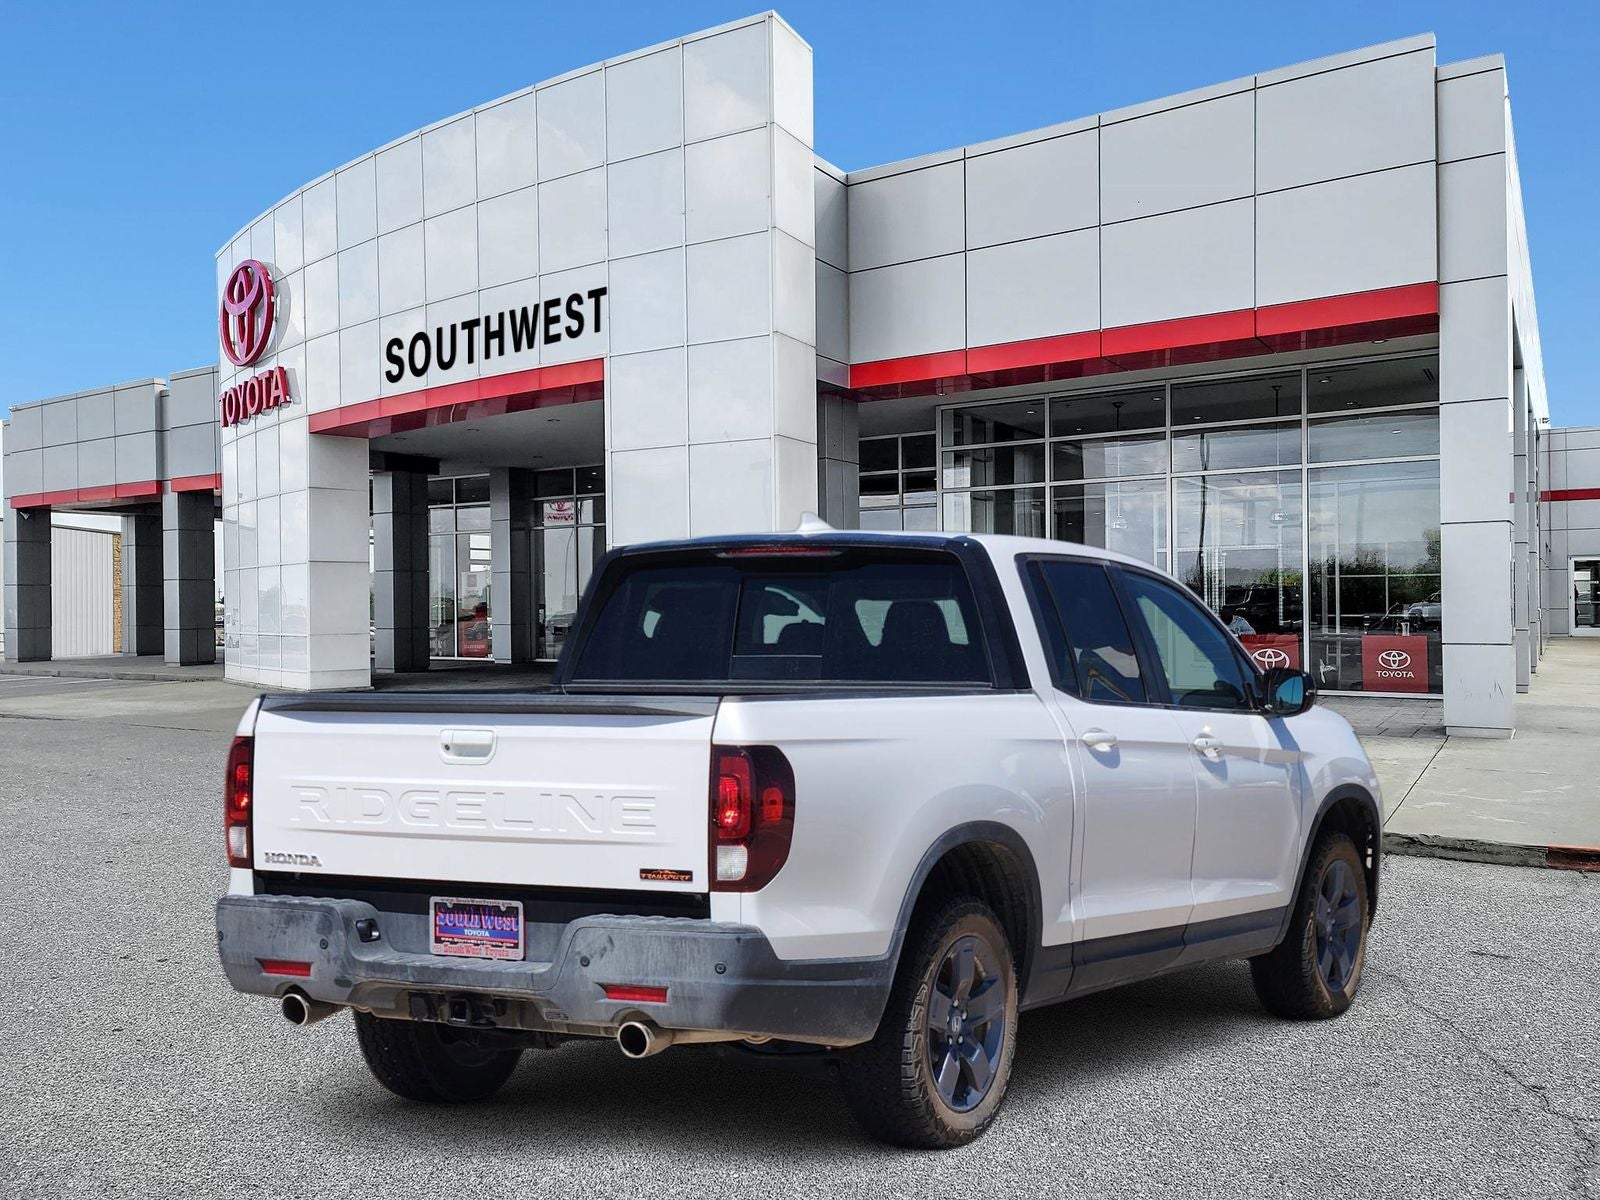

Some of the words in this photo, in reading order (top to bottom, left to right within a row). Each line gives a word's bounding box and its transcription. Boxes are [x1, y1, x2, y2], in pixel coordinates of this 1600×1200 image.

[385, 286, 608, 384] SOUTHWEST
[218, 366, 289, 427] TOYOTA
[1375, 670, 1415, 678] TOYOTA
[289, 785, 657, 835] RIDGELINE
[264, 851, 322, 867] HONDA
[464, 928, 490, 937] TOYOTA
